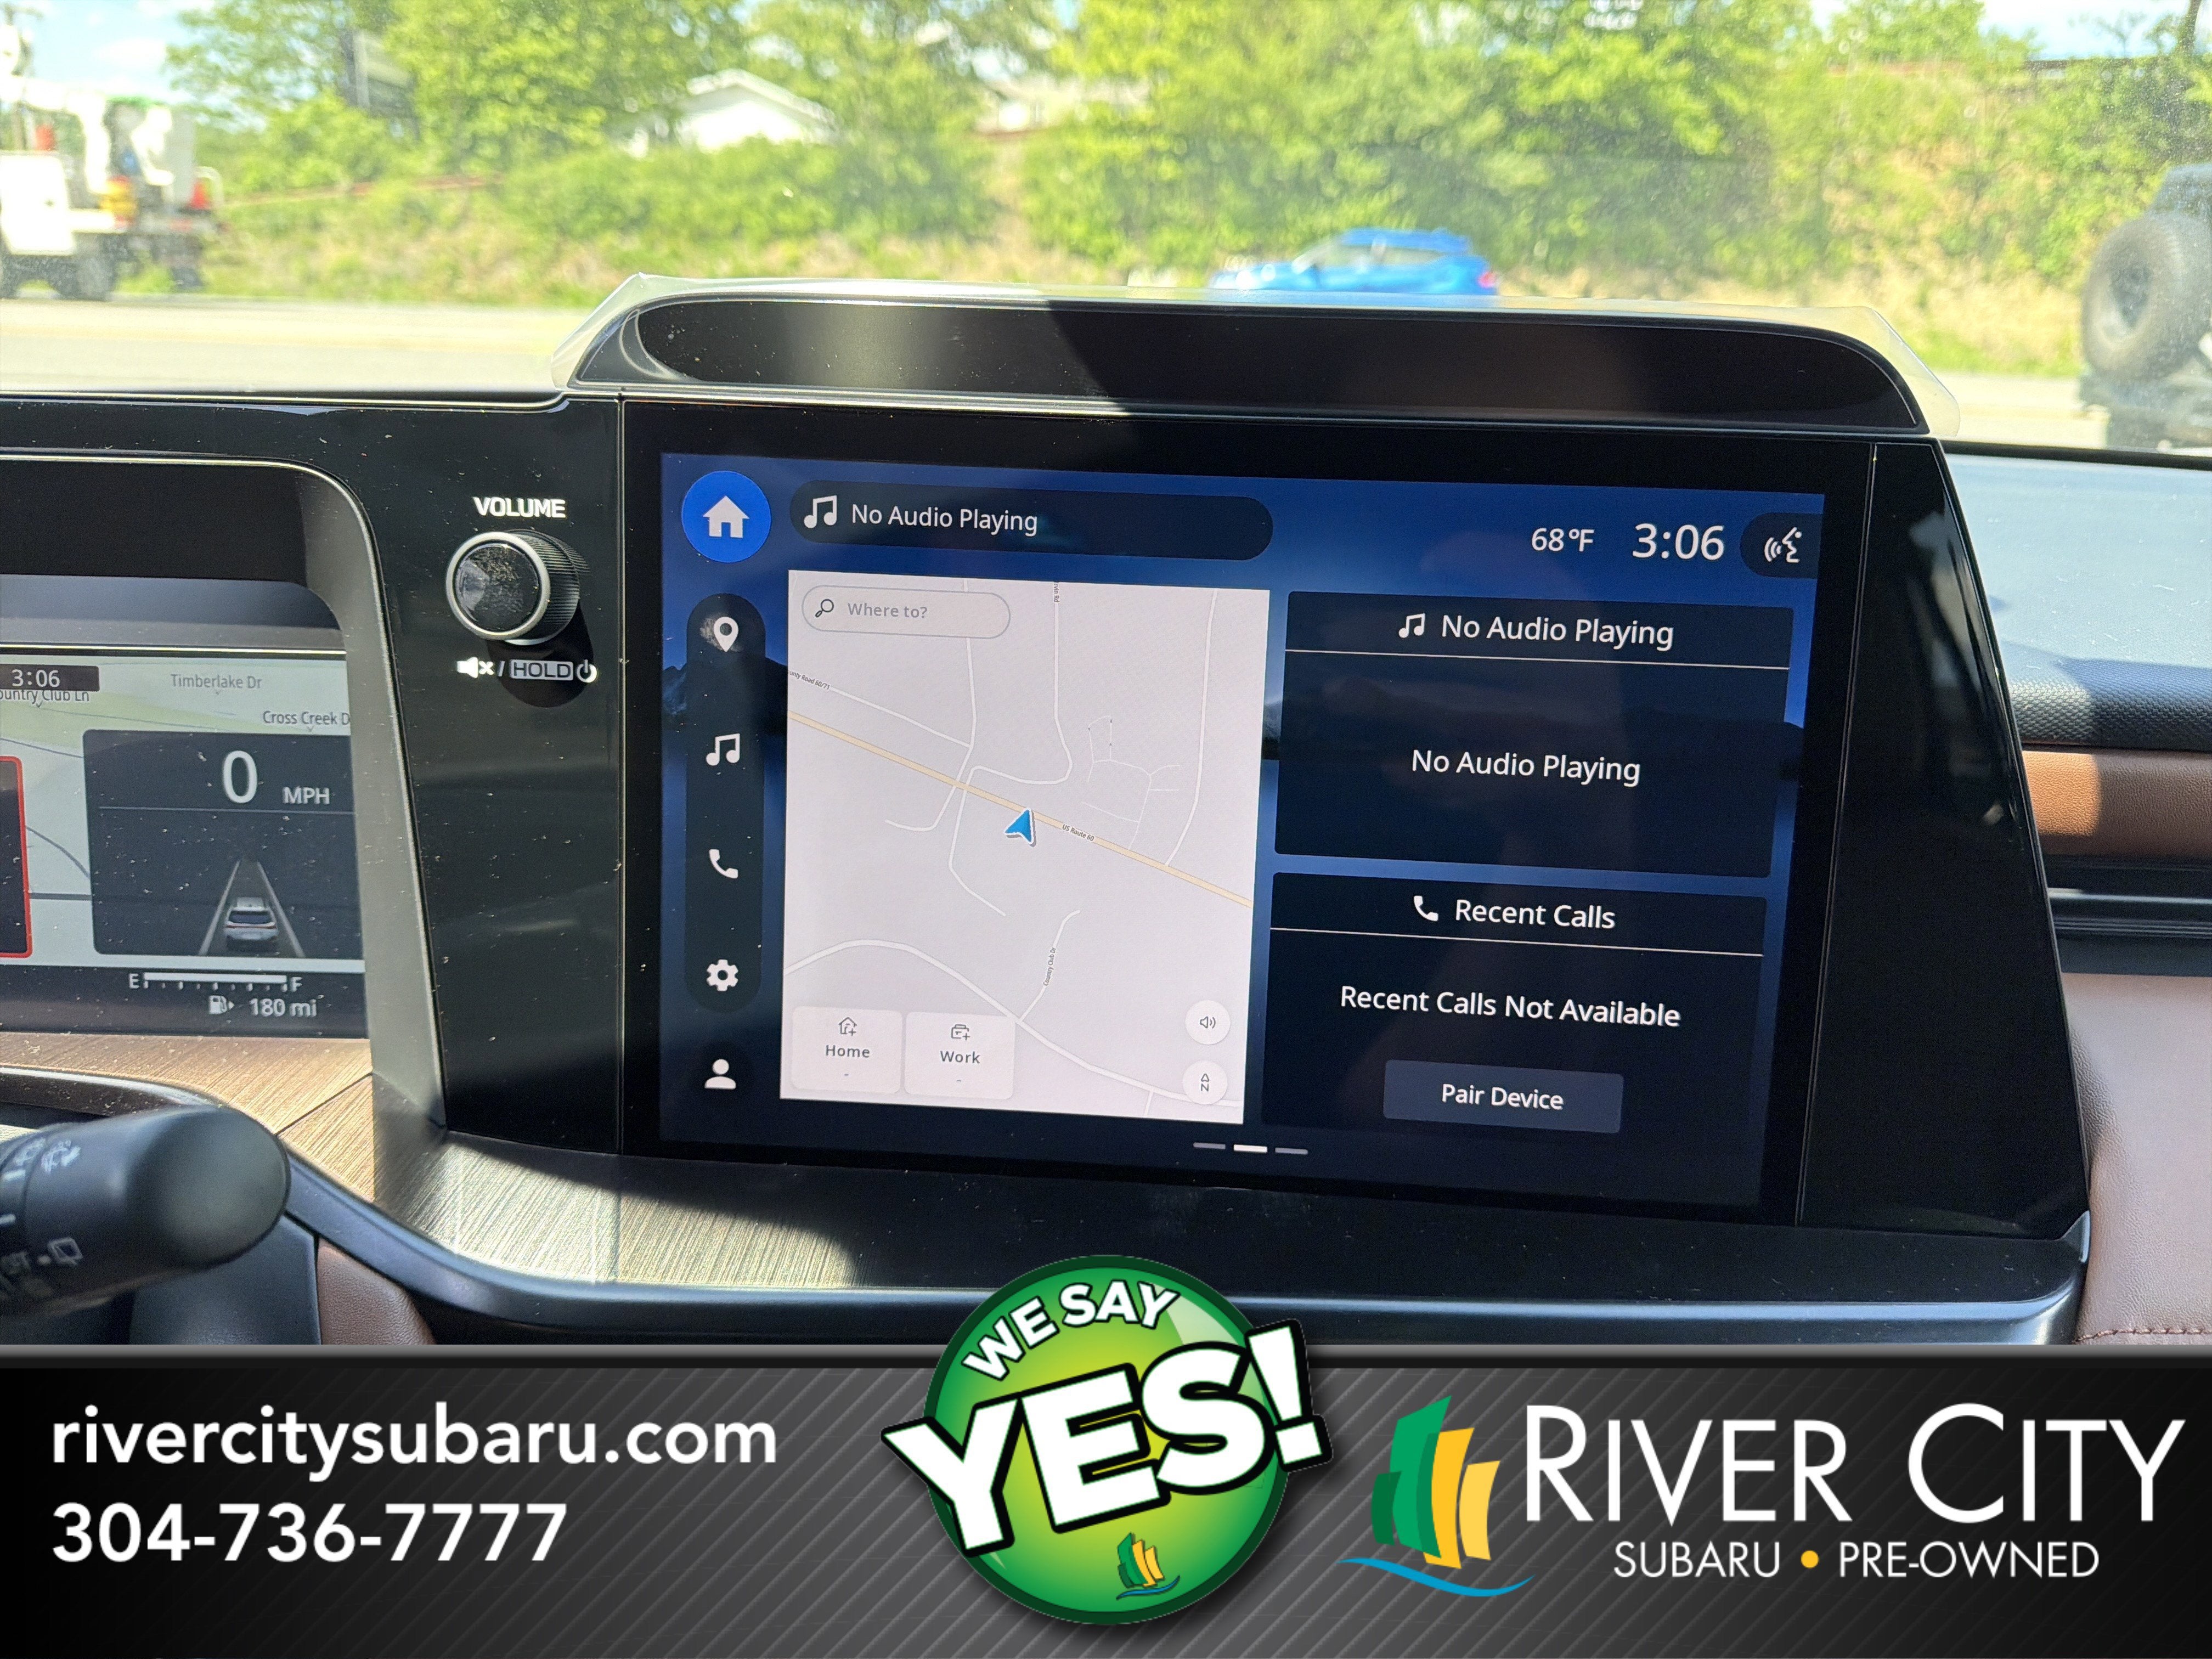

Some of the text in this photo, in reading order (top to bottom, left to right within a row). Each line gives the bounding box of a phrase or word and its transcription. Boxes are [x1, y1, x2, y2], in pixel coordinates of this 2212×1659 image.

[472, 496, 566, 518] VOLUME
[852, 504, 1037, 537] No Audio Playing
[1632, 523, 1724, 560] 3:06
[848, 602, 928, 618] Where to?
[1442, 614, 1674, 652] No Audio Playing
[12, 669, 60, 687] 3:06
[514, 663, 572, 678] HOLD
[171, 674, 262, 689] Timberlake Dr
[802, 675, 815, 684] Road
[42, 690, 70, 701] Club
[75, 691, 89, 702] Ln
[263, 710, 297, 725] Cross
[301, 712, 337, 726] Creek
[222, 750, 257, 803] 0
[1412, 749, 1641, 787] No Audio Playing
[283, 787, 330, 804] MPH
[1070, 827, 1086, 838] Route
[1455, 899, 1615, 929] Recent Calls
[129, 973, 139, 989] E
[290, 977, 302, 992] F
[1043, 966, 1054, 986] Country
[250, 998, 317, 1017] 180 mi
[1341, 985, 1681, 1027] Recent Calls Not Available
[825, 1043, 871, 1060] Home
[939, 1049, 981, 1066] Work
[1200, 1083, 1209, 1092] N
[1442, 1084, 1564, 1110] Pair Device
